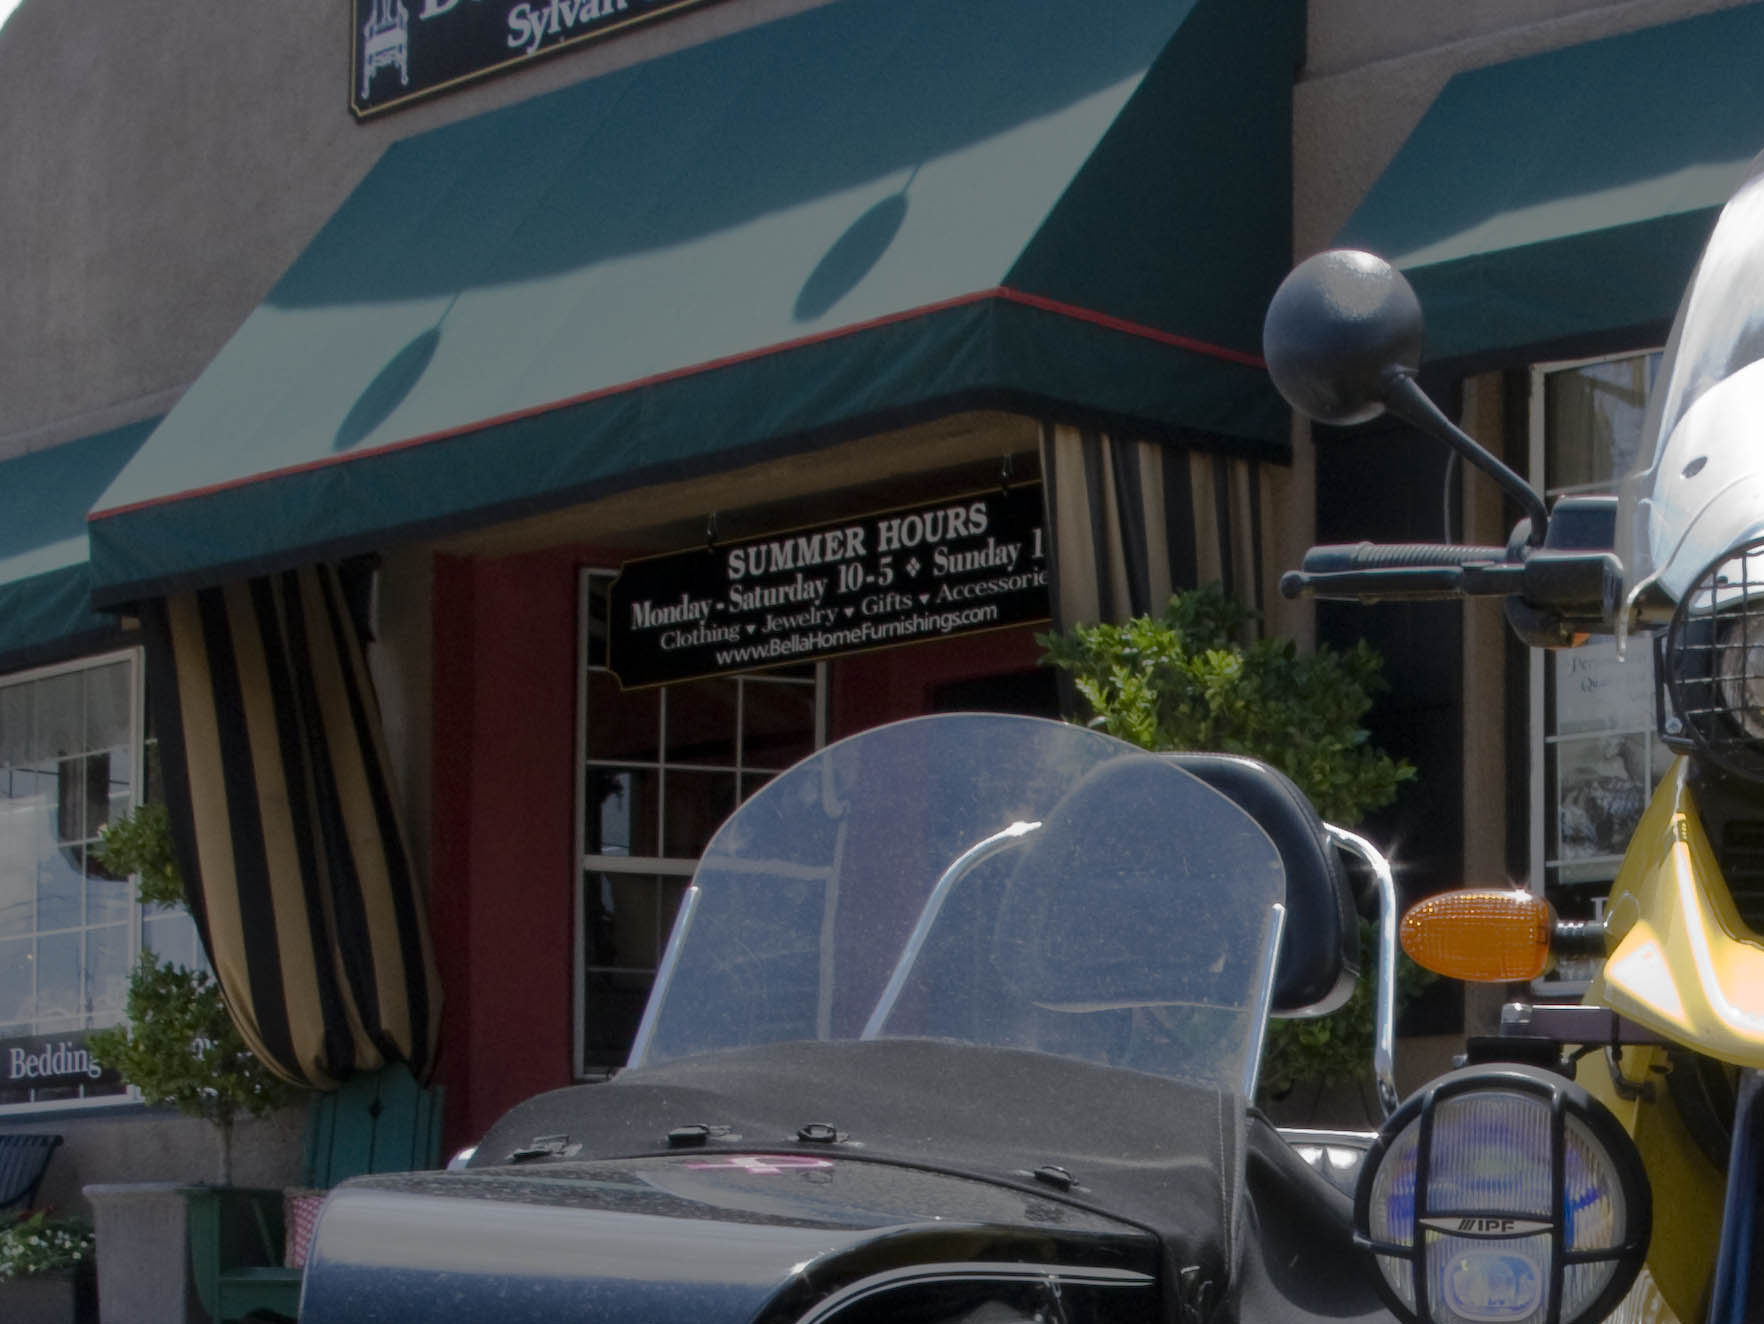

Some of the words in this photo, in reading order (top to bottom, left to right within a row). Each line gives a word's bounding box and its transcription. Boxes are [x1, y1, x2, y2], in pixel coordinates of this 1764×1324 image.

[728, 525, 867, 580] SUMMER
[877, 502, 989, 552] HOURS
[838, 556, 894, 593] 10-5
[933, 537, 1022, 576] Sunday
[660, 622, 741, 650] Clothing
[761, 607, 839, 633] Jewelry
[861, 592, 913, 616] Gifts
[716, 604, 998, 665] www.BellaHomeFurnishings.com
